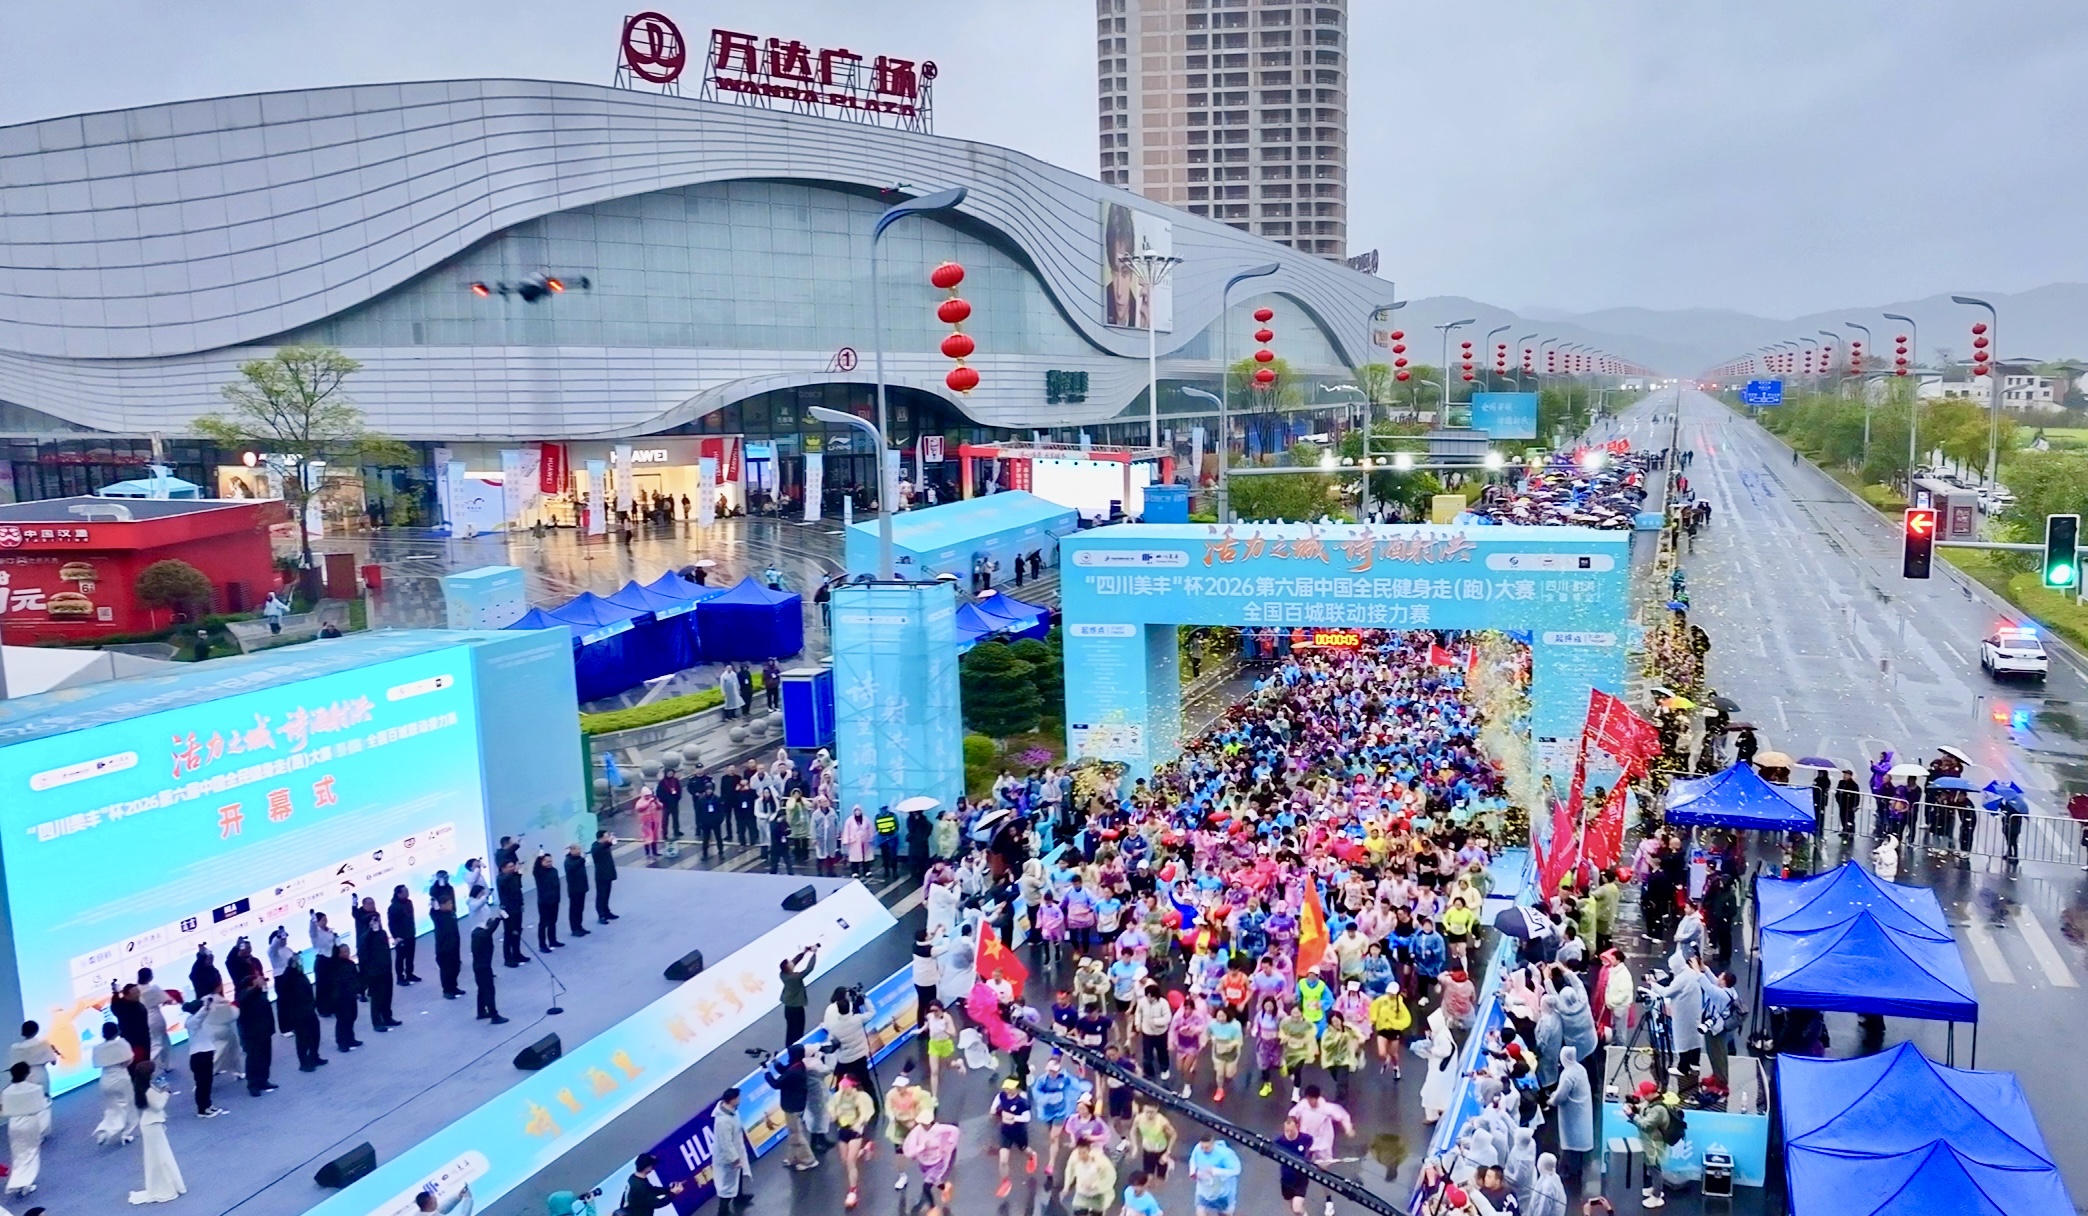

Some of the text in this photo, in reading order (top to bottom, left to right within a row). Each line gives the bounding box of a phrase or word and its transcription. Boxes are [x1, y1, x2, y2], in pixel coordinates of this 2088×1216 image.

[712, 29, 917, 99] 万达广场
[715, 76, 917, 117] WANDA PLAZA
[610, 449, 668, 464] HAWEI
[1243, 601, 1430, 624] 全国百城联动接力赛
